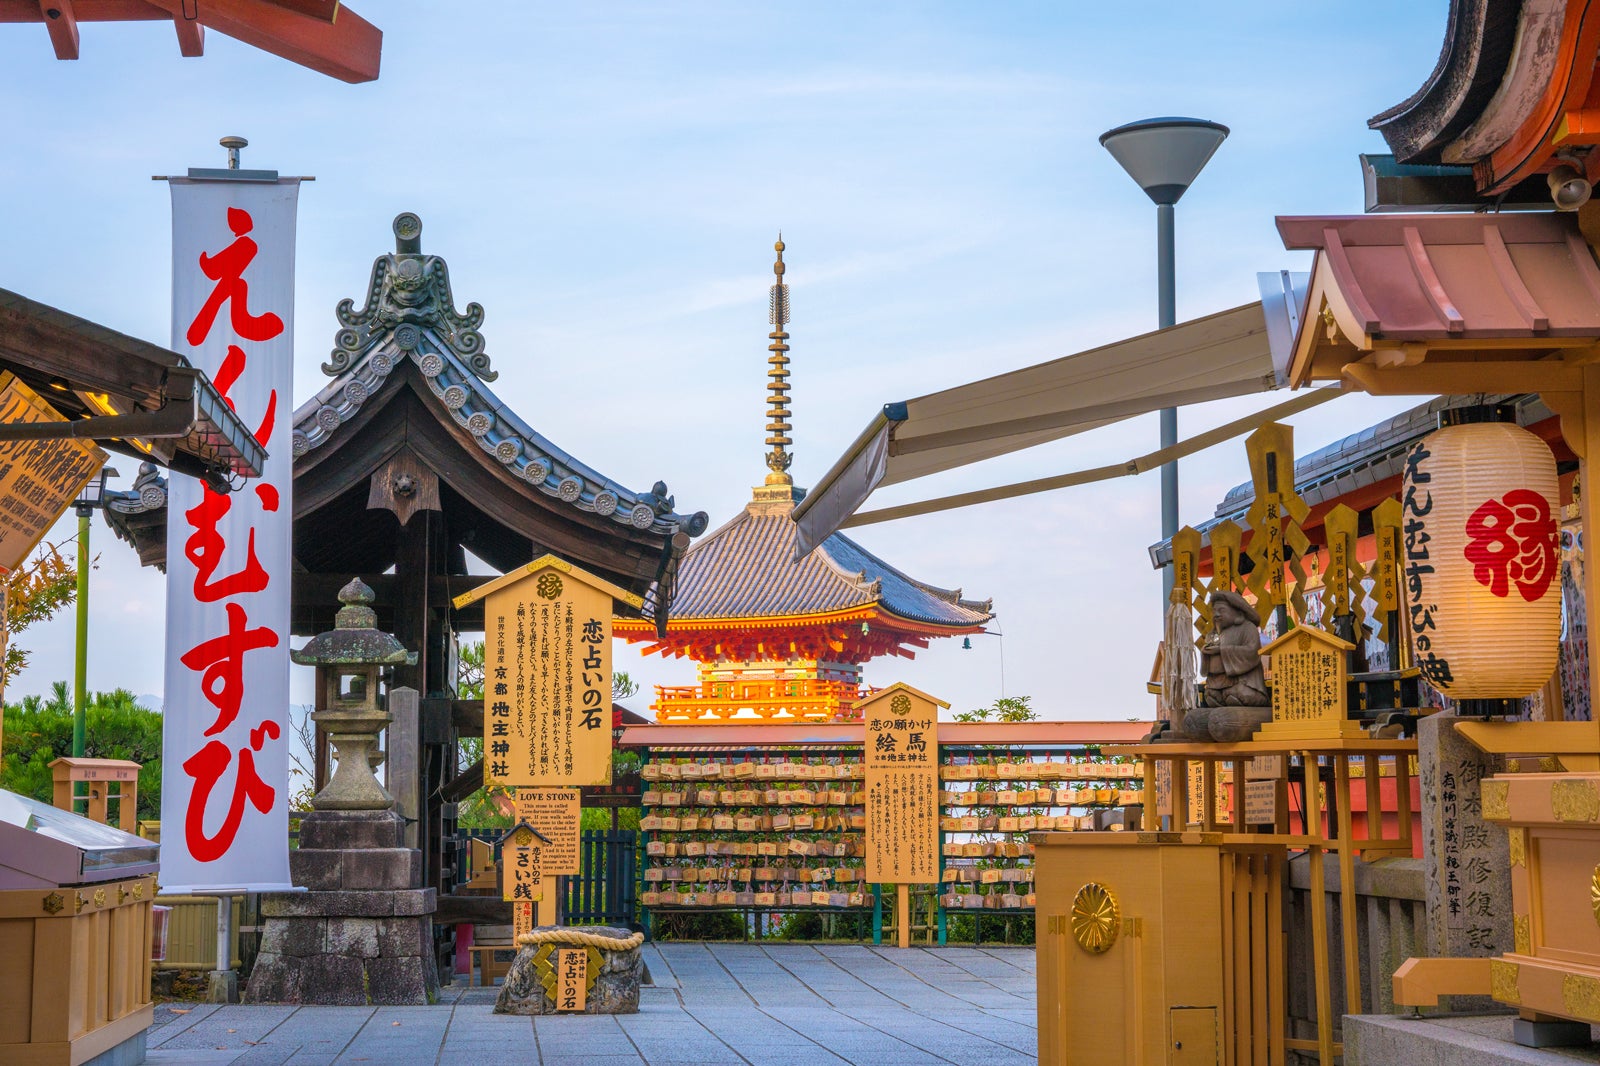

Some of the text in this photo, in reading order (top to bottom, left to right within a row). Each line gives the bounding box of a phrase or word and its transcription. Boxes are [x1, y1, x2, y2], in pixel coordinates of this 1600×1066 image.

[1266, 504, 1282, 594] 祓戸大神
[1402, 443, 1454, 689] えんむすびの神
[1464, 488, 1559, 602] 縁
[497, 616, 505, 663] 世界文化遺産
[516, 602, 526, 738] と願いを成就するにも人の助けがいるという。
[578, 618, 604, 730] 恋占いの石
[1322, 654, 1332, 710] 祓戸大神
[540, 604, 550, 776] 一度でできれば願いも早くかない、できなければ願いが
[552, 602, 561, 776] 石にたどりつくことができれば恋の願いがかなうという。
[564, 602, 574, 776] ご本殿前の左右にある守護石で両目をとじて反対側の
[870, 719, 932, 731] 恋の願かけ
[491, 702, 510, 777] 地主神社
[514, 852, 532, 900] さい銭
[532, 847, 541, 884] 恋占いの石
[562, 952, 578, 1008] 恋占いの石
